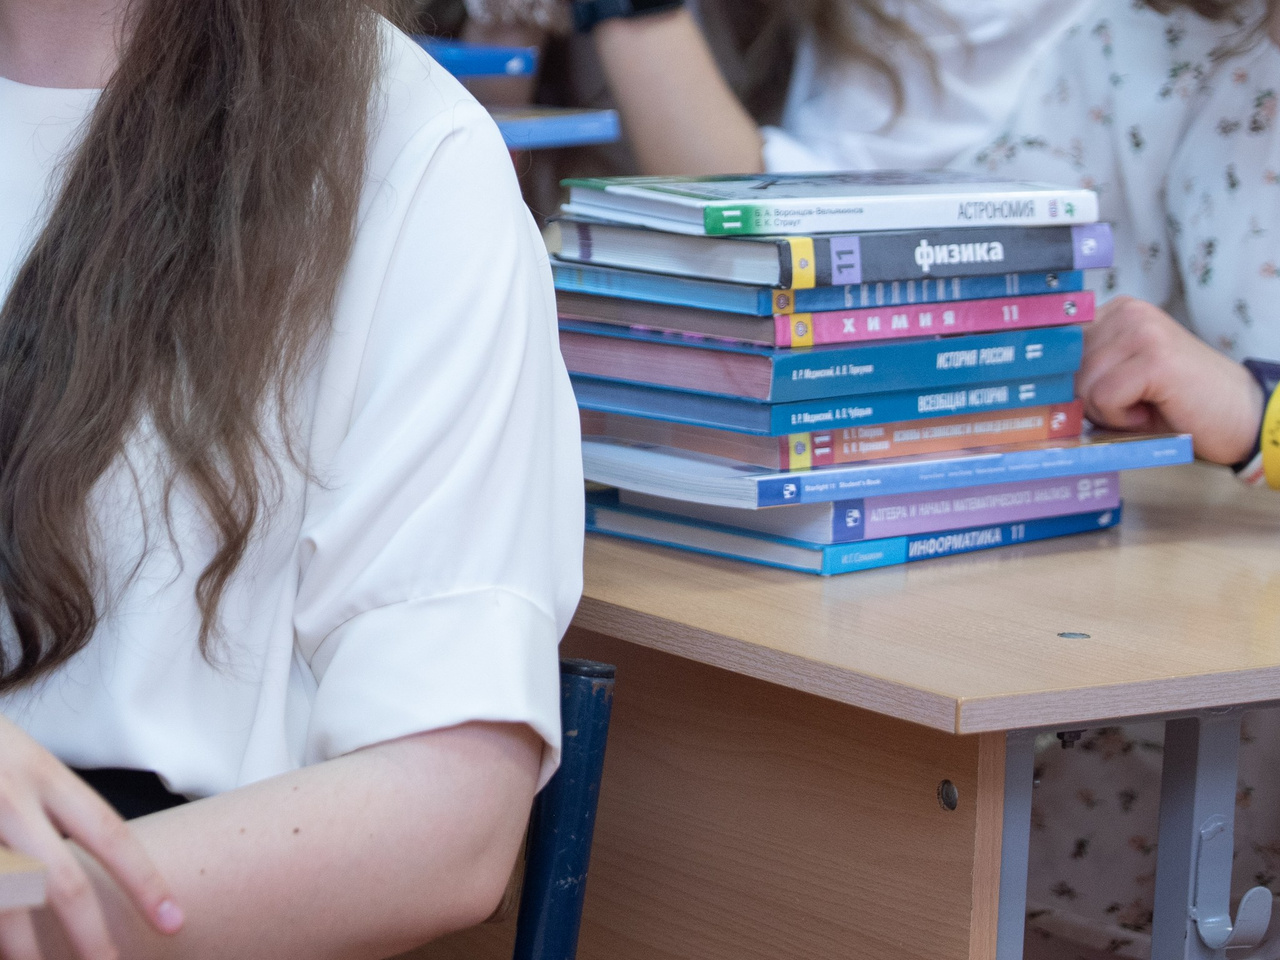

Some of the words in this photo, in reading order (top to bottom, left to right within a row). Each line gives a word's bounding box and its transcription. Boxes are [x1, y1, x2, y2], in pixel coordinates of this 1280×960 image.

[958, 200, 1035, 220] АСТРОНОМИЯ
[774, 218, 801, 228] Страут
[835, 248, 855, 275] 11
[914, 239, 1005, 273] физика
[1002, 305, 1019, 322] 11
[936, 349, 978, 370] ИСТОРИЯ
[979, 346, 1016, 366] РОССИИ
[918, 390, 967, 413] ВСЕОБЩАЯ
[968, 386, 1009, 407] ИСТОРИЯ
[870, 506, 907, 522] АЛГЕБРА
[908, 527, 1002, 557] ИНФОРМАТИКА
[1010, 523, 1026, 540] 11
